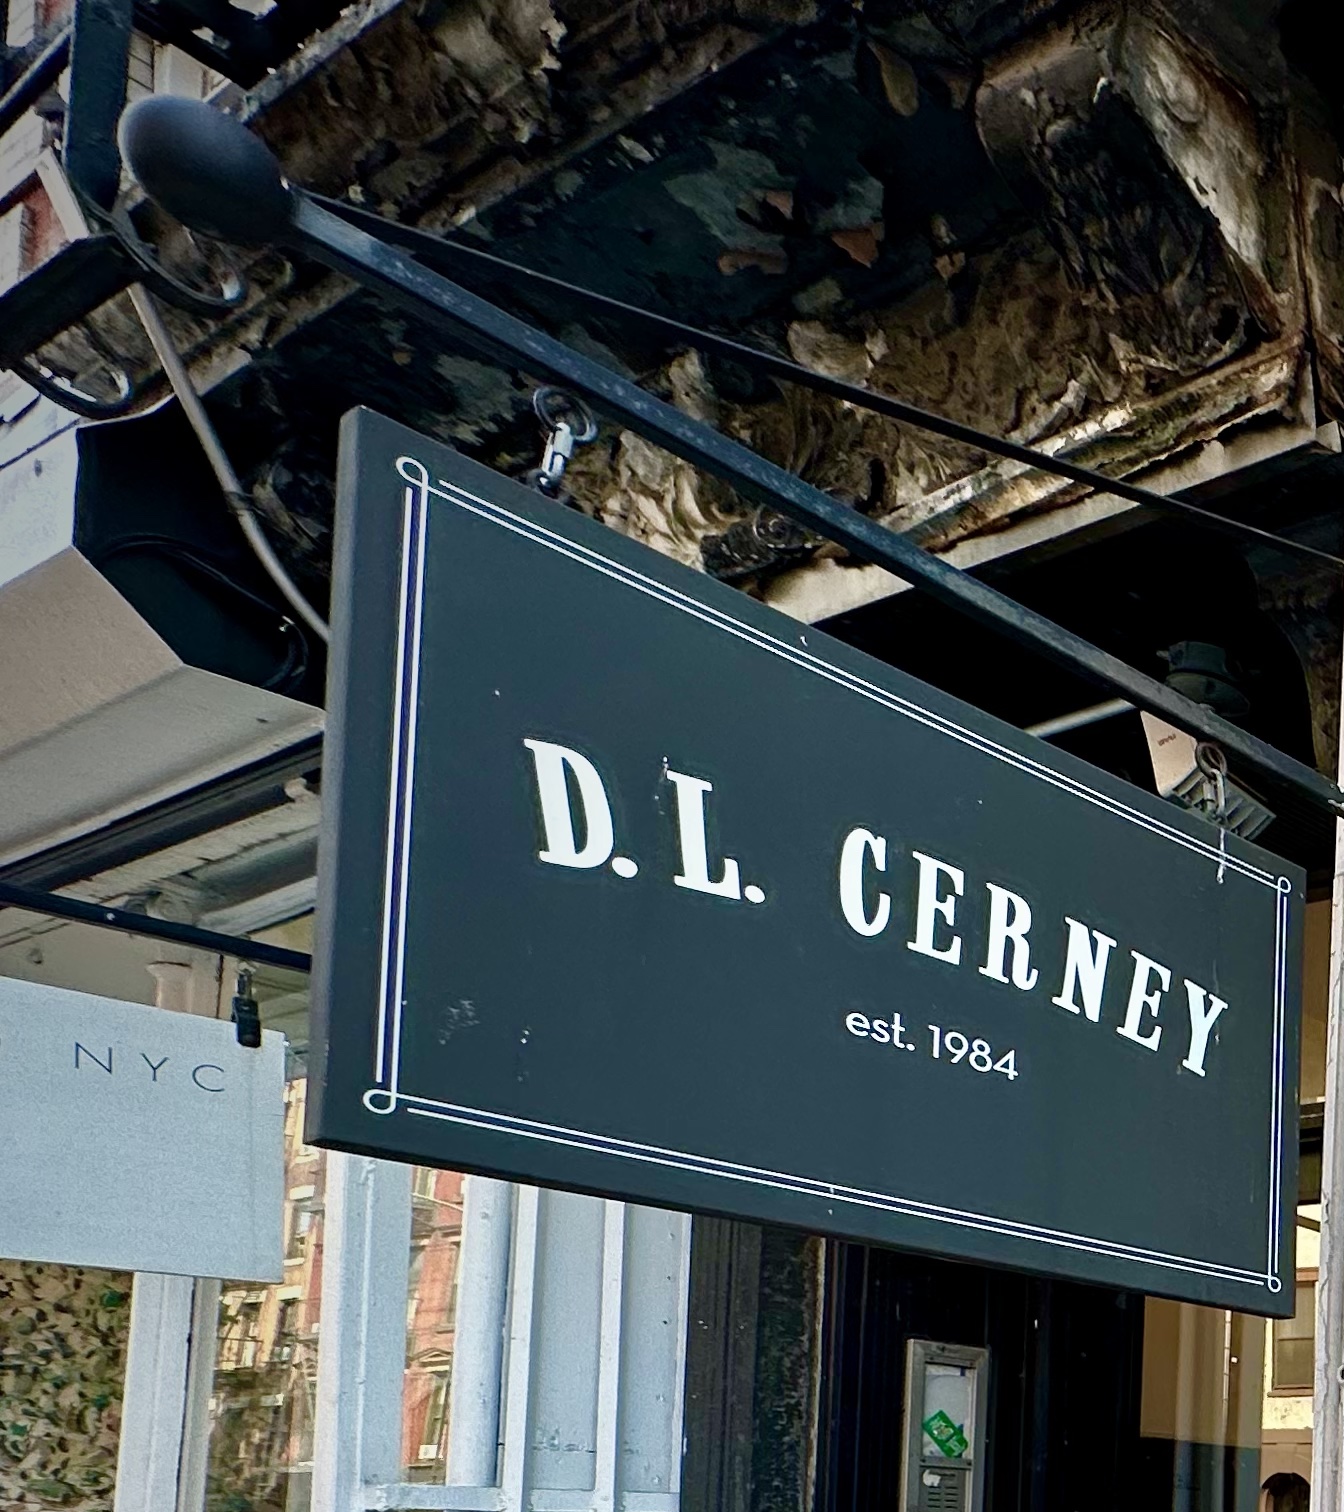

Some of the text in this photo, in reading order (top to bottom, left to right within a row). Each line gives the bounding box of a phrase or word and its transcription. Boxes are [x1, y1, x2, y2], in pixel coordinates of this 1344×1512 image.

[840, 827, 1229, 1077] CERNEY
[845, 1012, 1019, 1081] est. 1984
